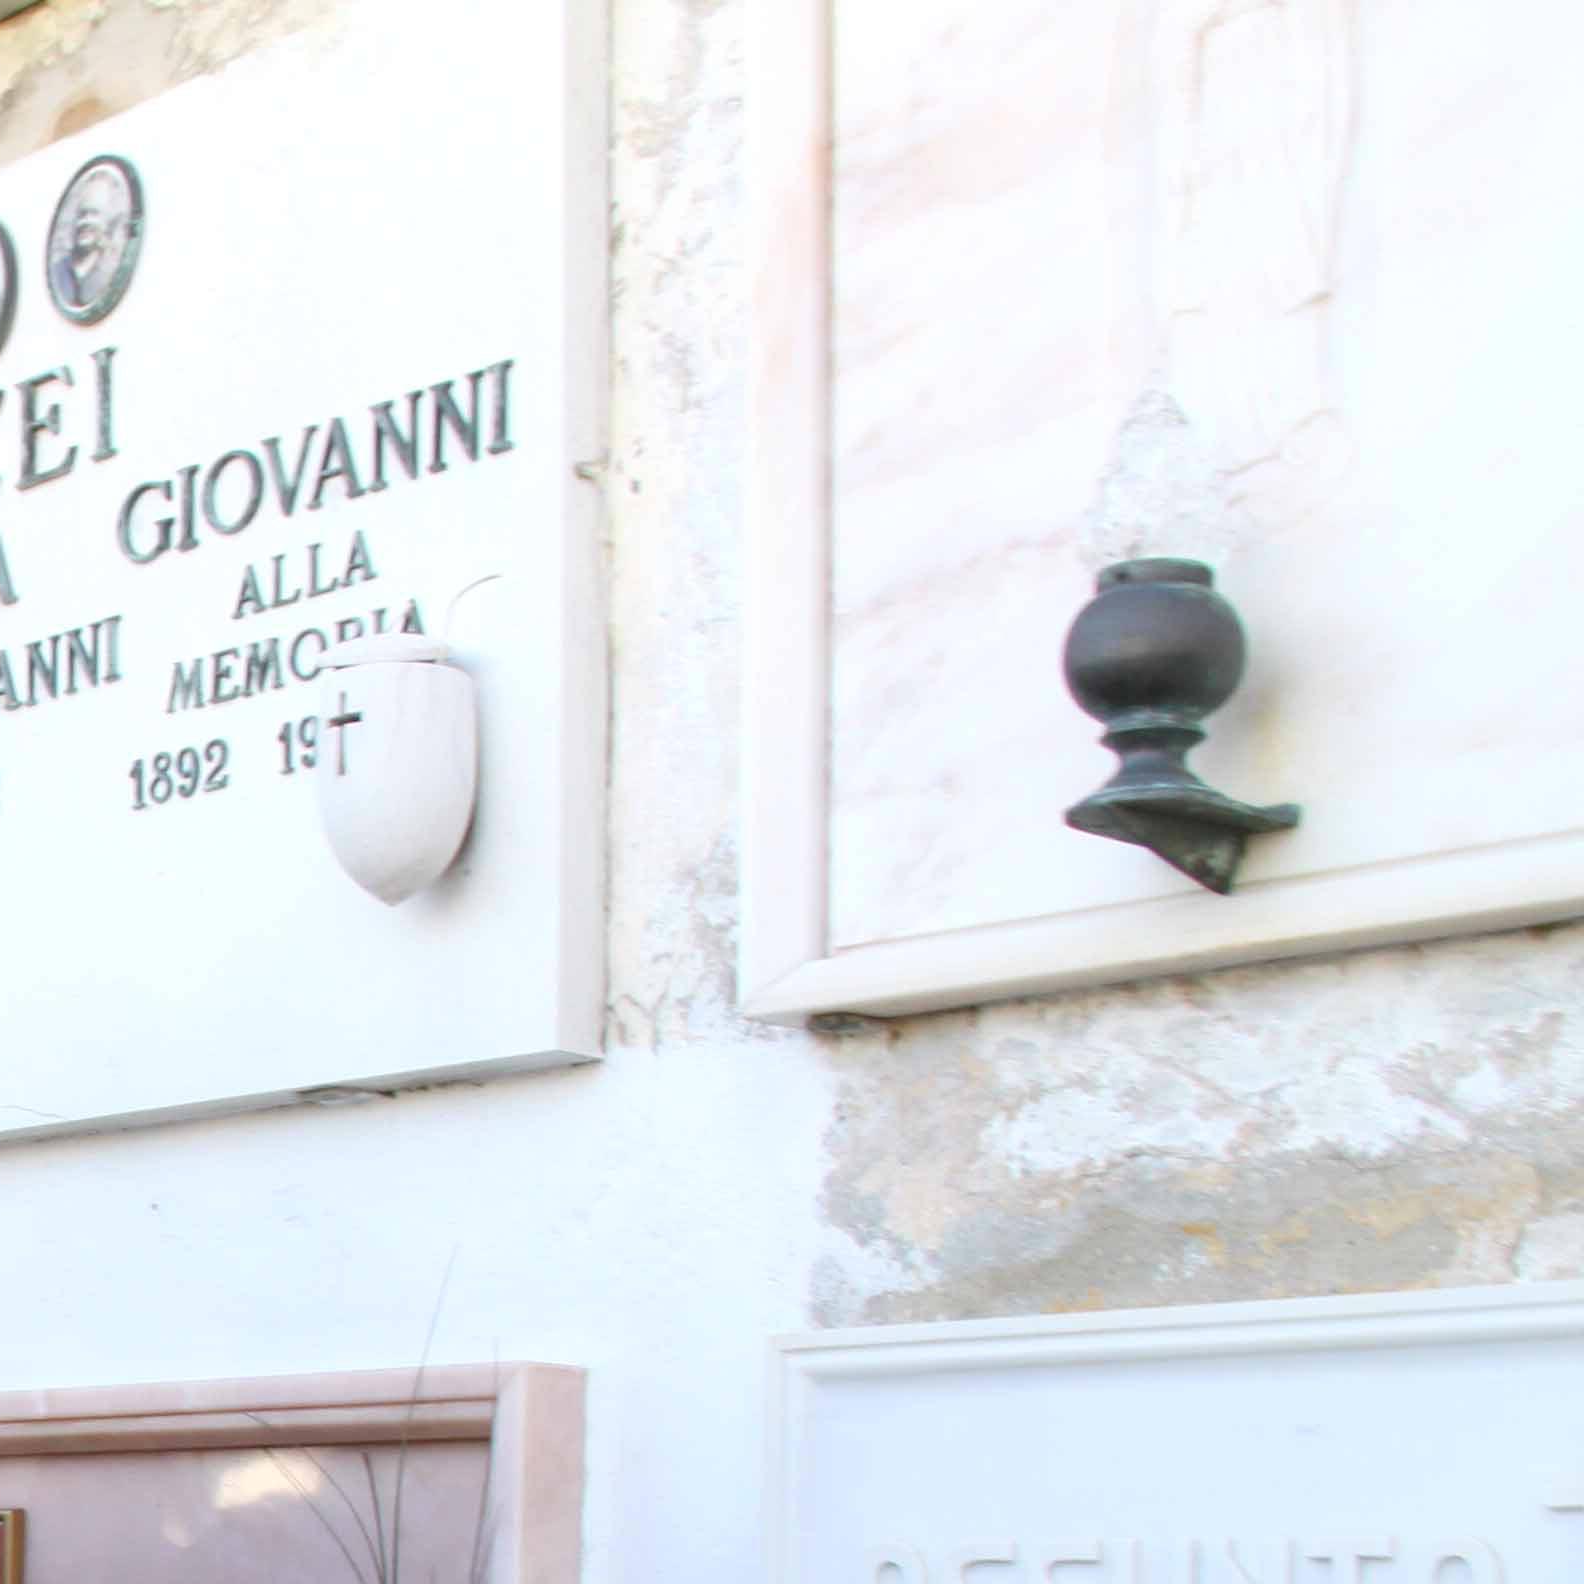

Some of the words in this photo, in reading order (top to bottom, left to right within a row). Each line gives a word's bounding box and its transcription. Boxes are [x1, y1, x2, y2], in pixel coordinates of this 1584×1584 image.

[117, 359, 515, 565] GIOVANNI
[232, 531, 378, 619] ALLA
[130, 739, 230, 811] 1892
[278, 715, 319, 775] 19
